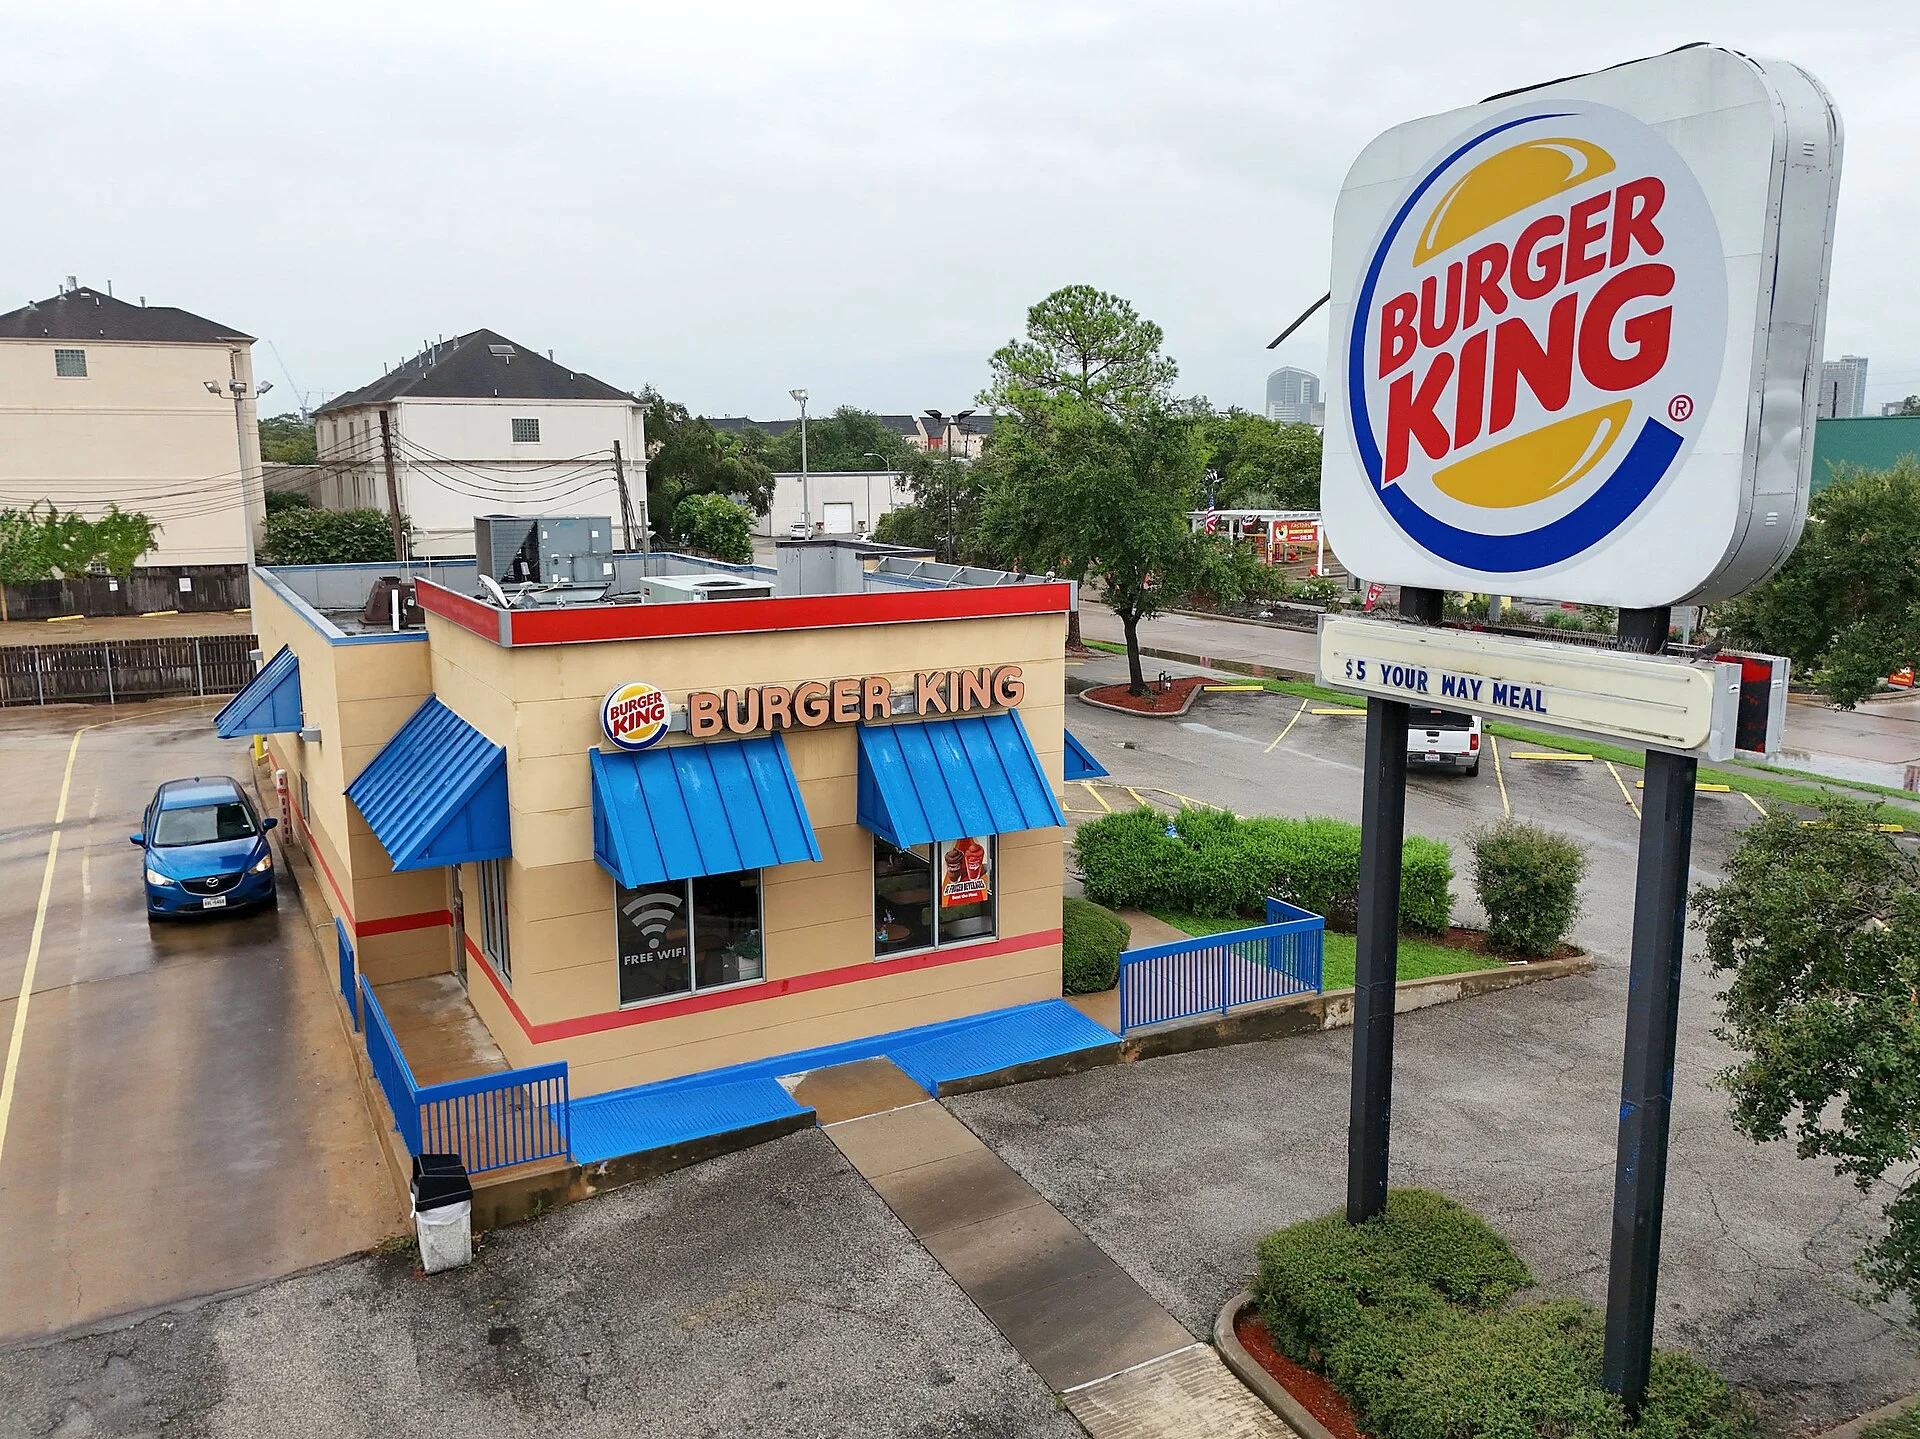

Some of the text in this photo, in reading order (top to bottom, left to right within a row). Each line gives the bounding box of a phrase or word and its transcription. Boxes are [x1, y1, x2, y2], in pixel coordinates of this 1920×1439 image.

[1378, 176, 1666, 380] BURGER
[1383, 263, 1675, 485] KING
[610, 691, 662, 720] BURGER
[688, 665, 1025, 737] BURGER KING
[1345, 658, 1547, 713] $5 YOUR WAY MEAL
[613, 703, 665, 738] KING
[624, 947, 686, 966] FREE WIFI
